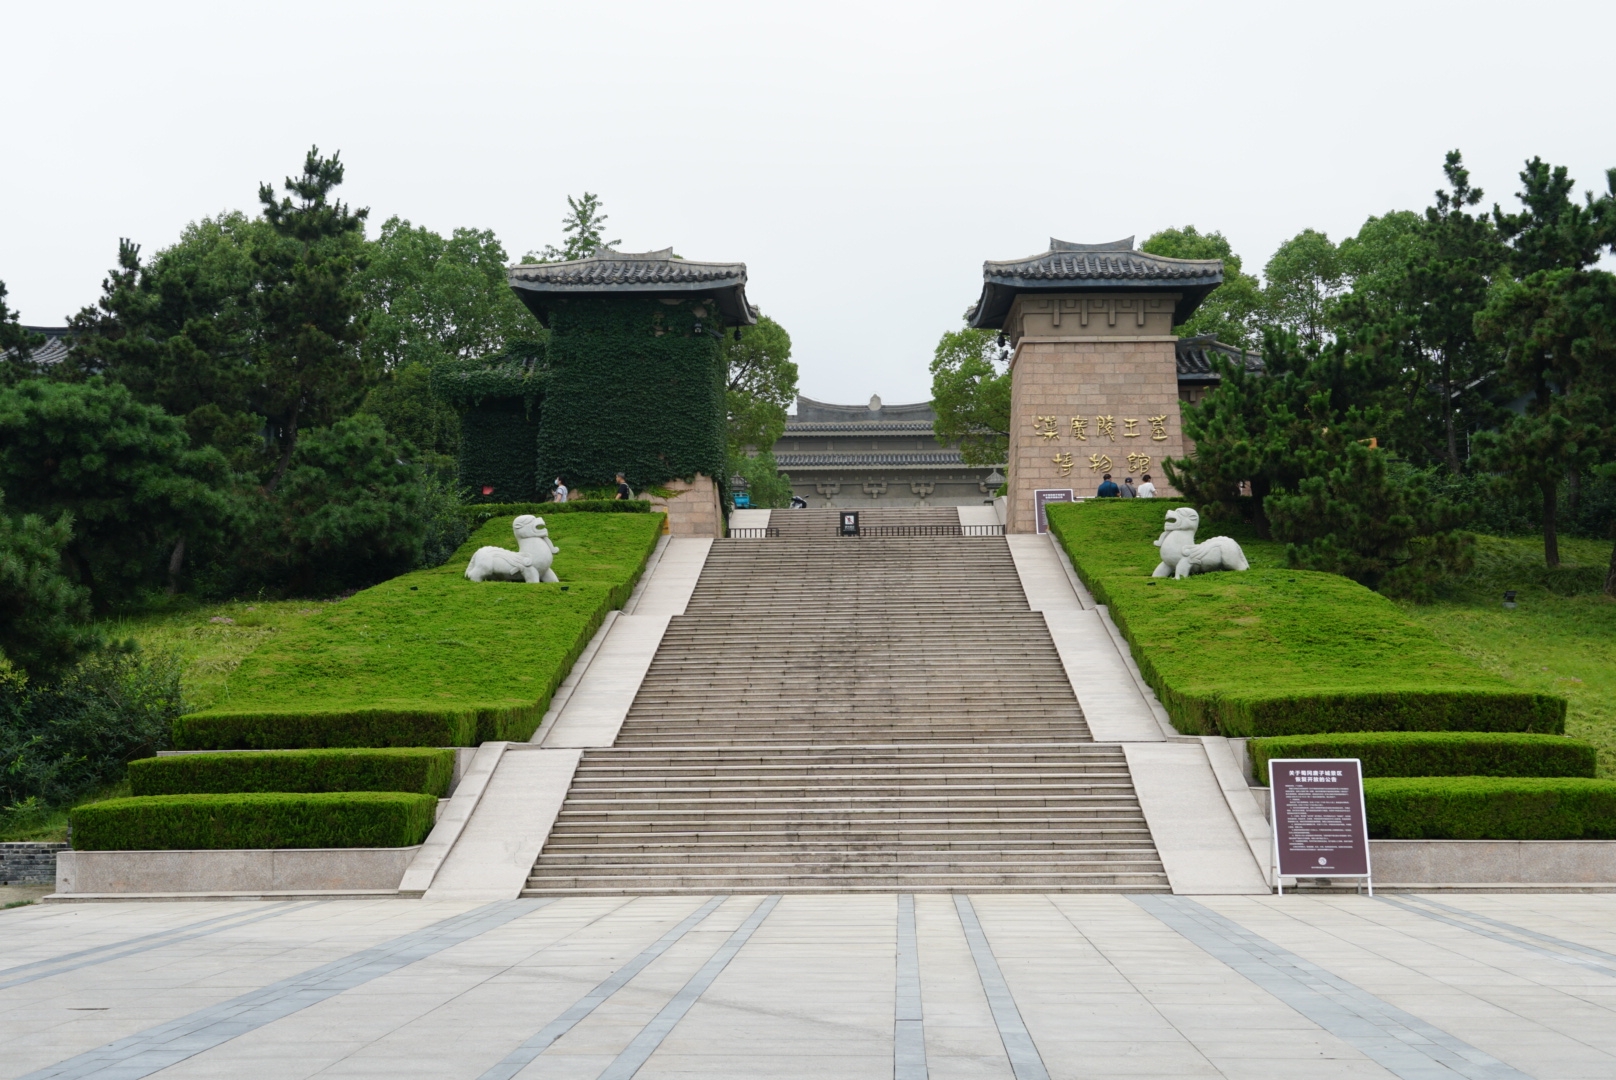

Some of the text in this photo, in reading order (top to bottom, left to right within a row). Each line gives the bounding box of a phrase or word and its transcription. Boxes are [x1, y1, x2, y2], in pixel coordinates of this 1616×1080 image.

[1033, 414, 1168, 442] 漢廣陵王墓
[1052, 452, 1151, 477] 博物館
